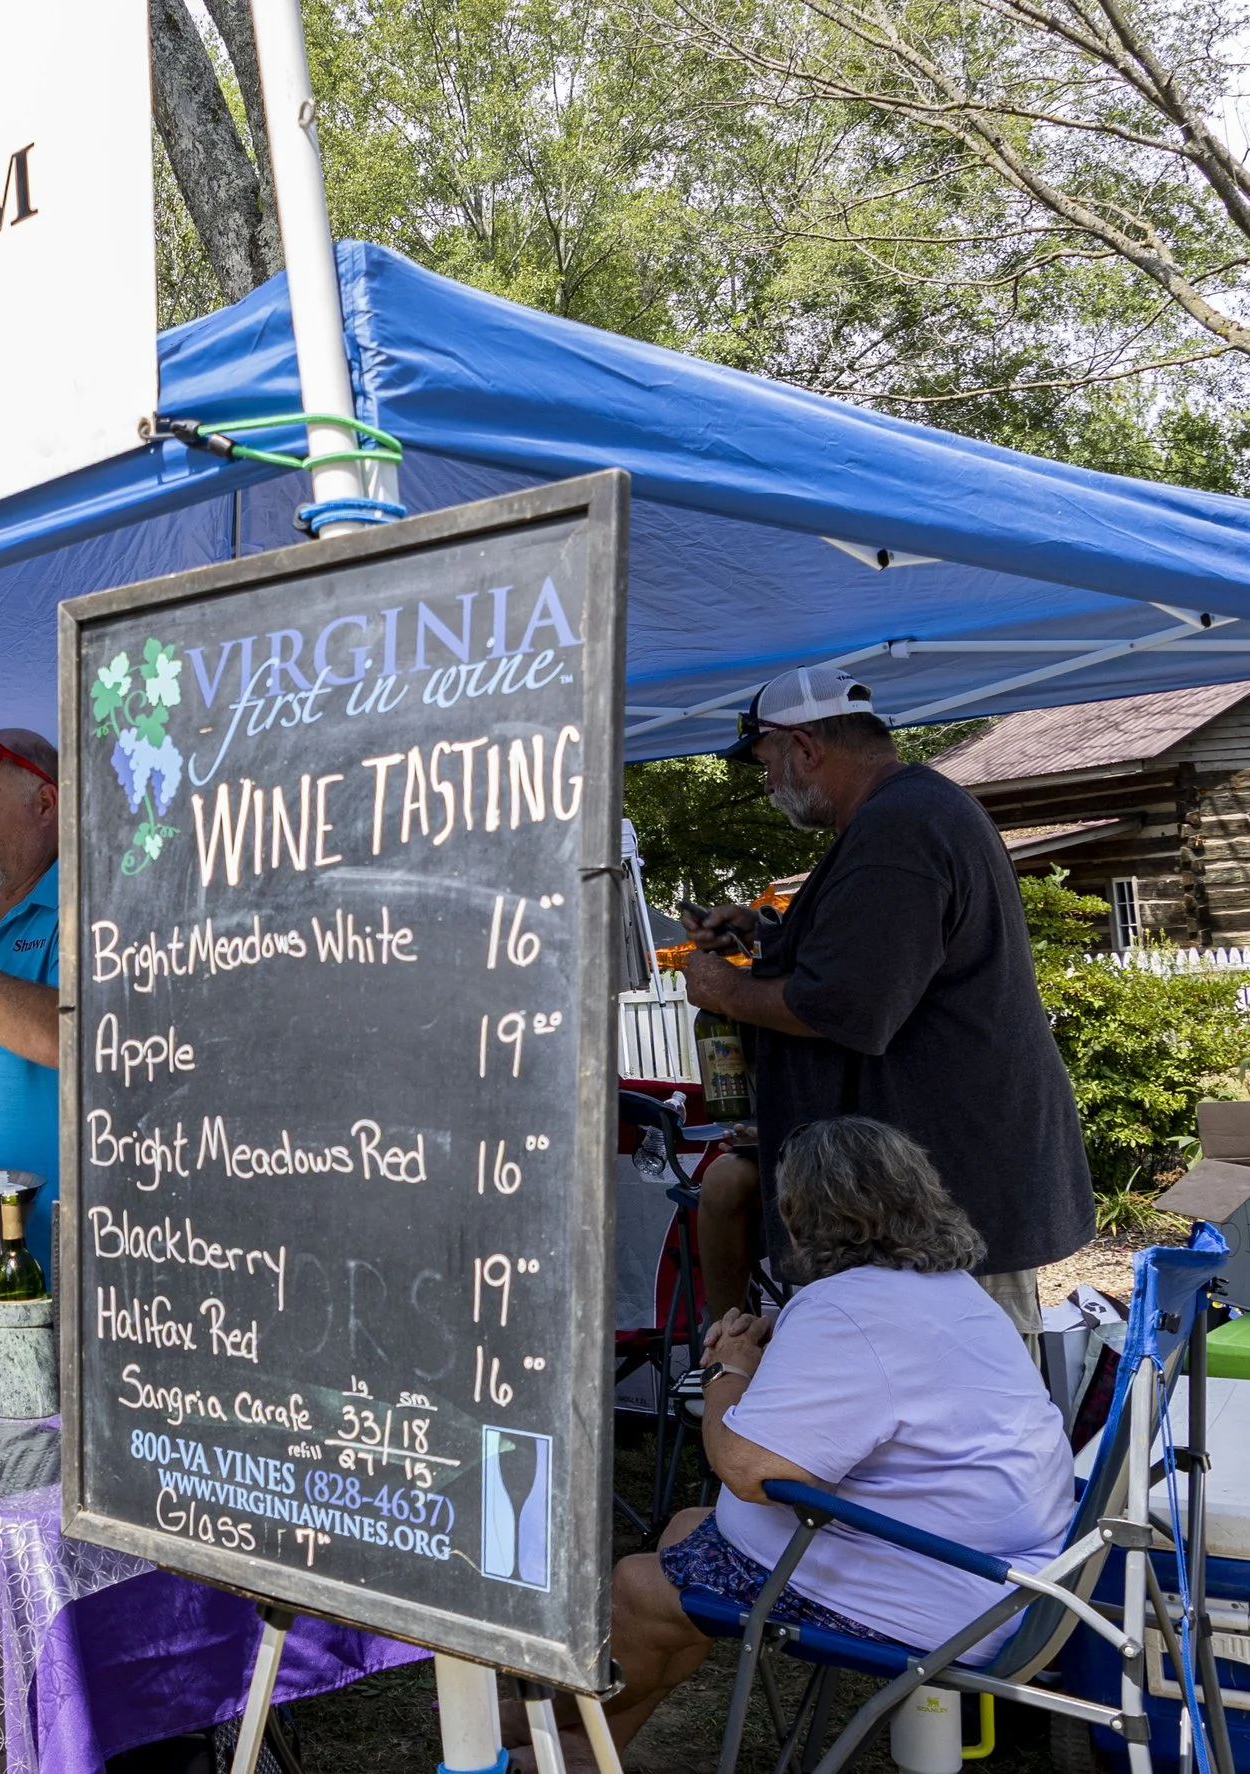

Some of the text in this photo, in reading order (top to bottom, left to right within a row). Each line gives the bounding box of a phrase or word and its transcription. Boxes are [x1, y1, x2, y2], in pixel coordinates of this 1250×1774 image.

[184, 575, 584, 709] VIRGINIA
[189, 656, 338, 787] first
[346, 658, 411, 716] in
[191, 724, 584, 888] WINE TASTING
[90, 906, 418, 993] Bright Meadows White
[94, 1012, 197, 1087] Apple
[86, 1108, 428, 1192] Bright Meadows Red
[88, 1205, 286, 1312] Blackberry
[97, 1285, 259, 1364] Halifax Red
[118, 1362, 228, 1426] Sangria
[131, 1428, 456, 1534] 800-VA VINES (828-4637)
[288, 1441, 322, 1460] refill
[156, 1486, 257, 1551] Glass
[157, 1467, 452, 1560] WWW.VIRGINIAWINES.ORG
